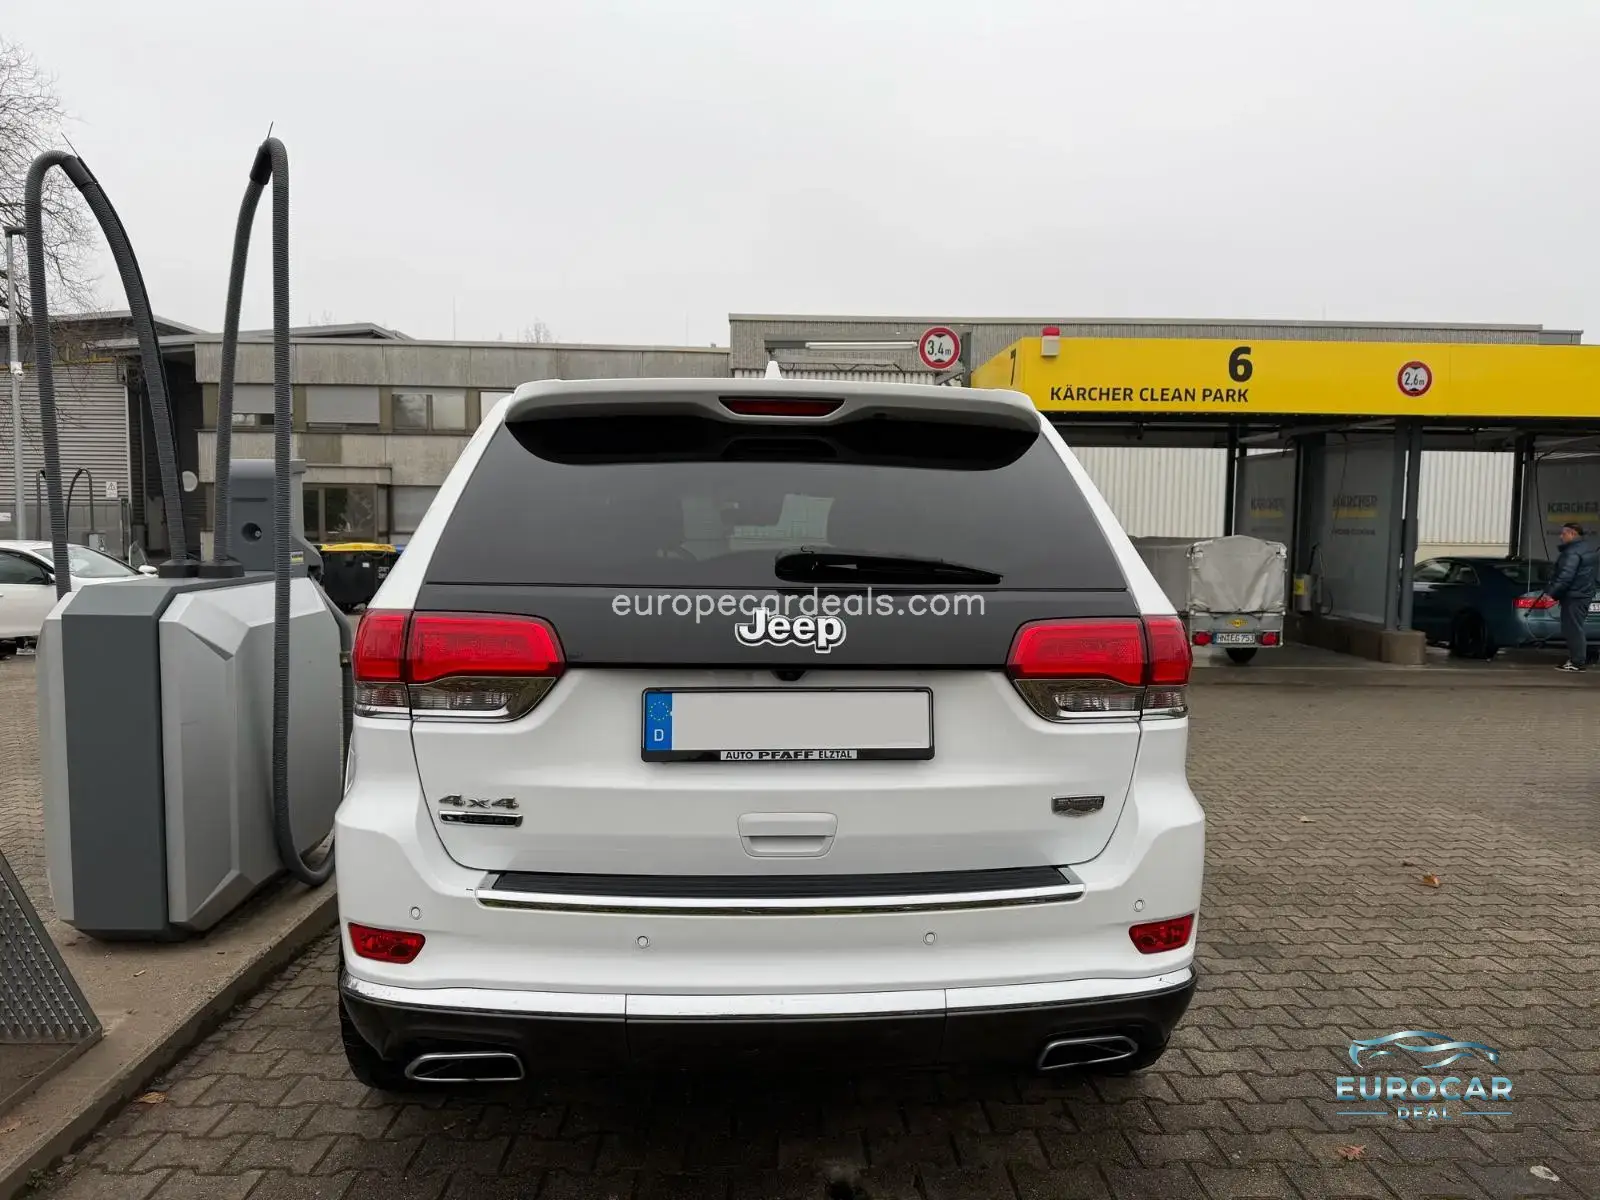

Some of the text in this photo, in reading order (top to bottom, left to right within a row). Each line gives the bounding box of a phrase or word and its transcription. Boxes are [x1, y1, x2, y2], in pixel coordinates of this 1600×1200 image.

[1010, 348, 1017, 387] 7
[1228, 346, 1254, 383] 6
[1050, 384, 1249, 403] KÄRCHER CLEAN PARK
[735, 607, 846, 653] Jeep
[653, 728, 664, 742] D
[725, 750, 853, 760] AUTO PFAFF ELZTAL
